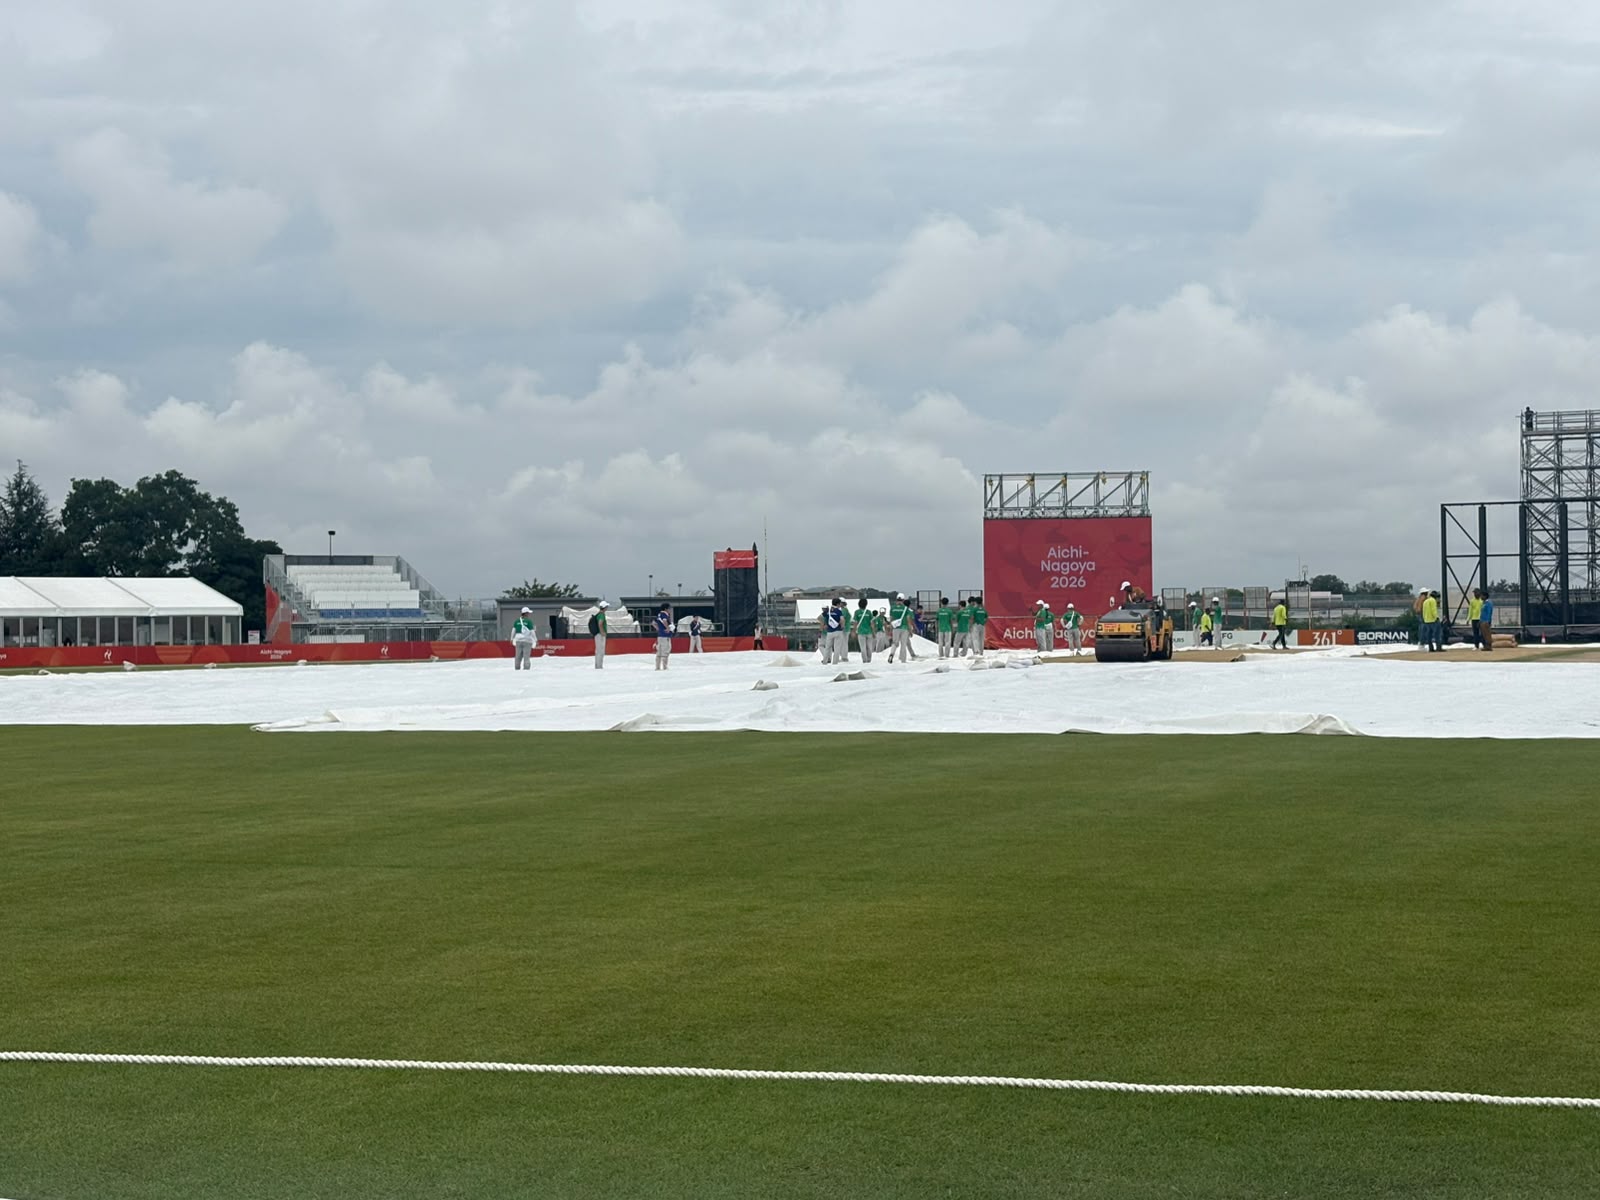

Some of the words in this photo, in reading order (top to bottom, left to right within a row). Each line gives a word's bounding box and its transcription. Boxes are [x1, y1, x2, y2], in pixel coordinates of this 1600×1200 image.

[1047, 545, 1089, 559] Aichi-
[1041, 559, 1096, 575] Nagoya
[1050, 576, 1087, 588] 2026
[1357, 631, 1409, 641] BORNAN
